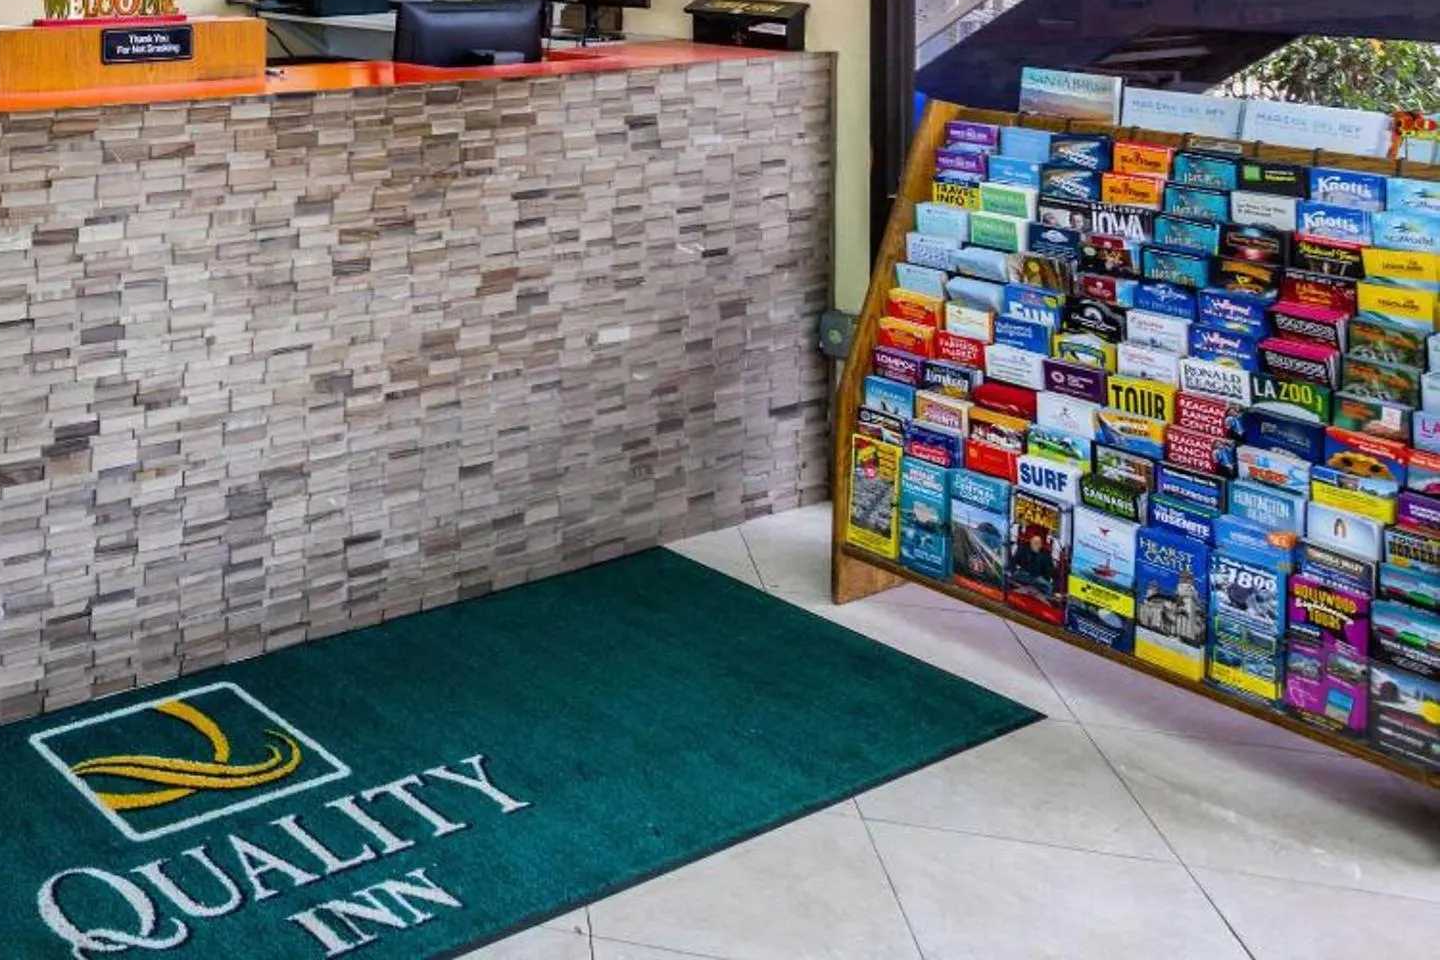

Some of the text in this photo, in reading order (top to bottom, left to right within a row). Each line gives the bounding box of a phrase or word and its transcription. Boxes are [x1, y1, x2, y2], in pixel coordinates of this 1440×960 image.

[128, 33, 170, 44] Thank You
[116, 45, 131, 54] For
[132, 44, 146, 53] Not
[936, 192, 965, 206] INFO
[1090, 210, 1146, 241] IOWA
[876, 353, 917, 372] LOMPOC
[1184, 364, 1242, 384] RONALD
[1185, 376, 1243, 396] REAGAN
[1253, 376, 1313, 405] LA ZOO
[1111, 383, 1166, 421] TOUR
[1179, 398, 1226, 418] REAGAN
[1179, 418, 1225, 437] CENTER
[1182, 409, 1223, 426] RANCH
[1167, 432, 1211, 452] REAGAN
[1170, 443, 1210, 460] RANCH
[1168, 451, 1213, 472] CENTER
[1019, 462, 1068, 492] SURF
[1153, 508, 1210, 537] YOSEMITE
[1139, 537, 1195, 564] HEARST
[1145, 549, 1194, 574] CASTLE
[37, 753, 532, 960] QUALITY
[286, 867, 463, 958] INN
